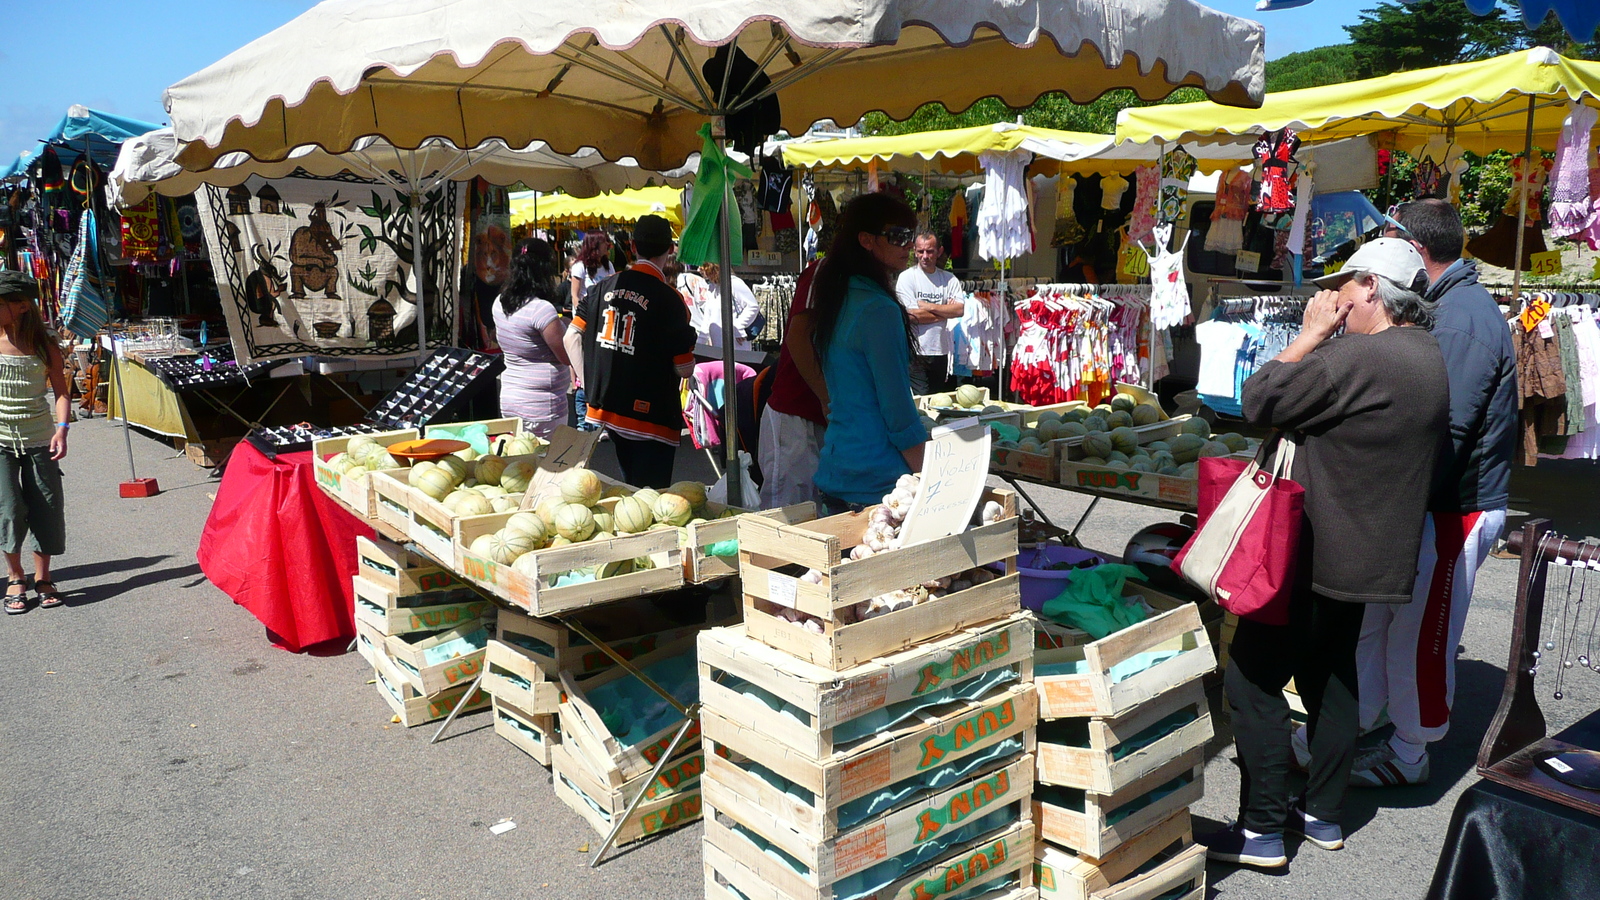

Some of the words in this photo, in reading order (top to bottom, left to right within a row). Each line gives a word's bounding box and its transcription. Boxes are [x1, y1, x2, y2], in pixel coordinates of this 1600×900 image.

[1130, 250, 1147, 275] 10
[603, 288, 650, 311] OFFICIAL
[917, 291, 944, 300] Reebok
[596, 303, 637, 356] 11
[552, 444, 574, 468] 4
